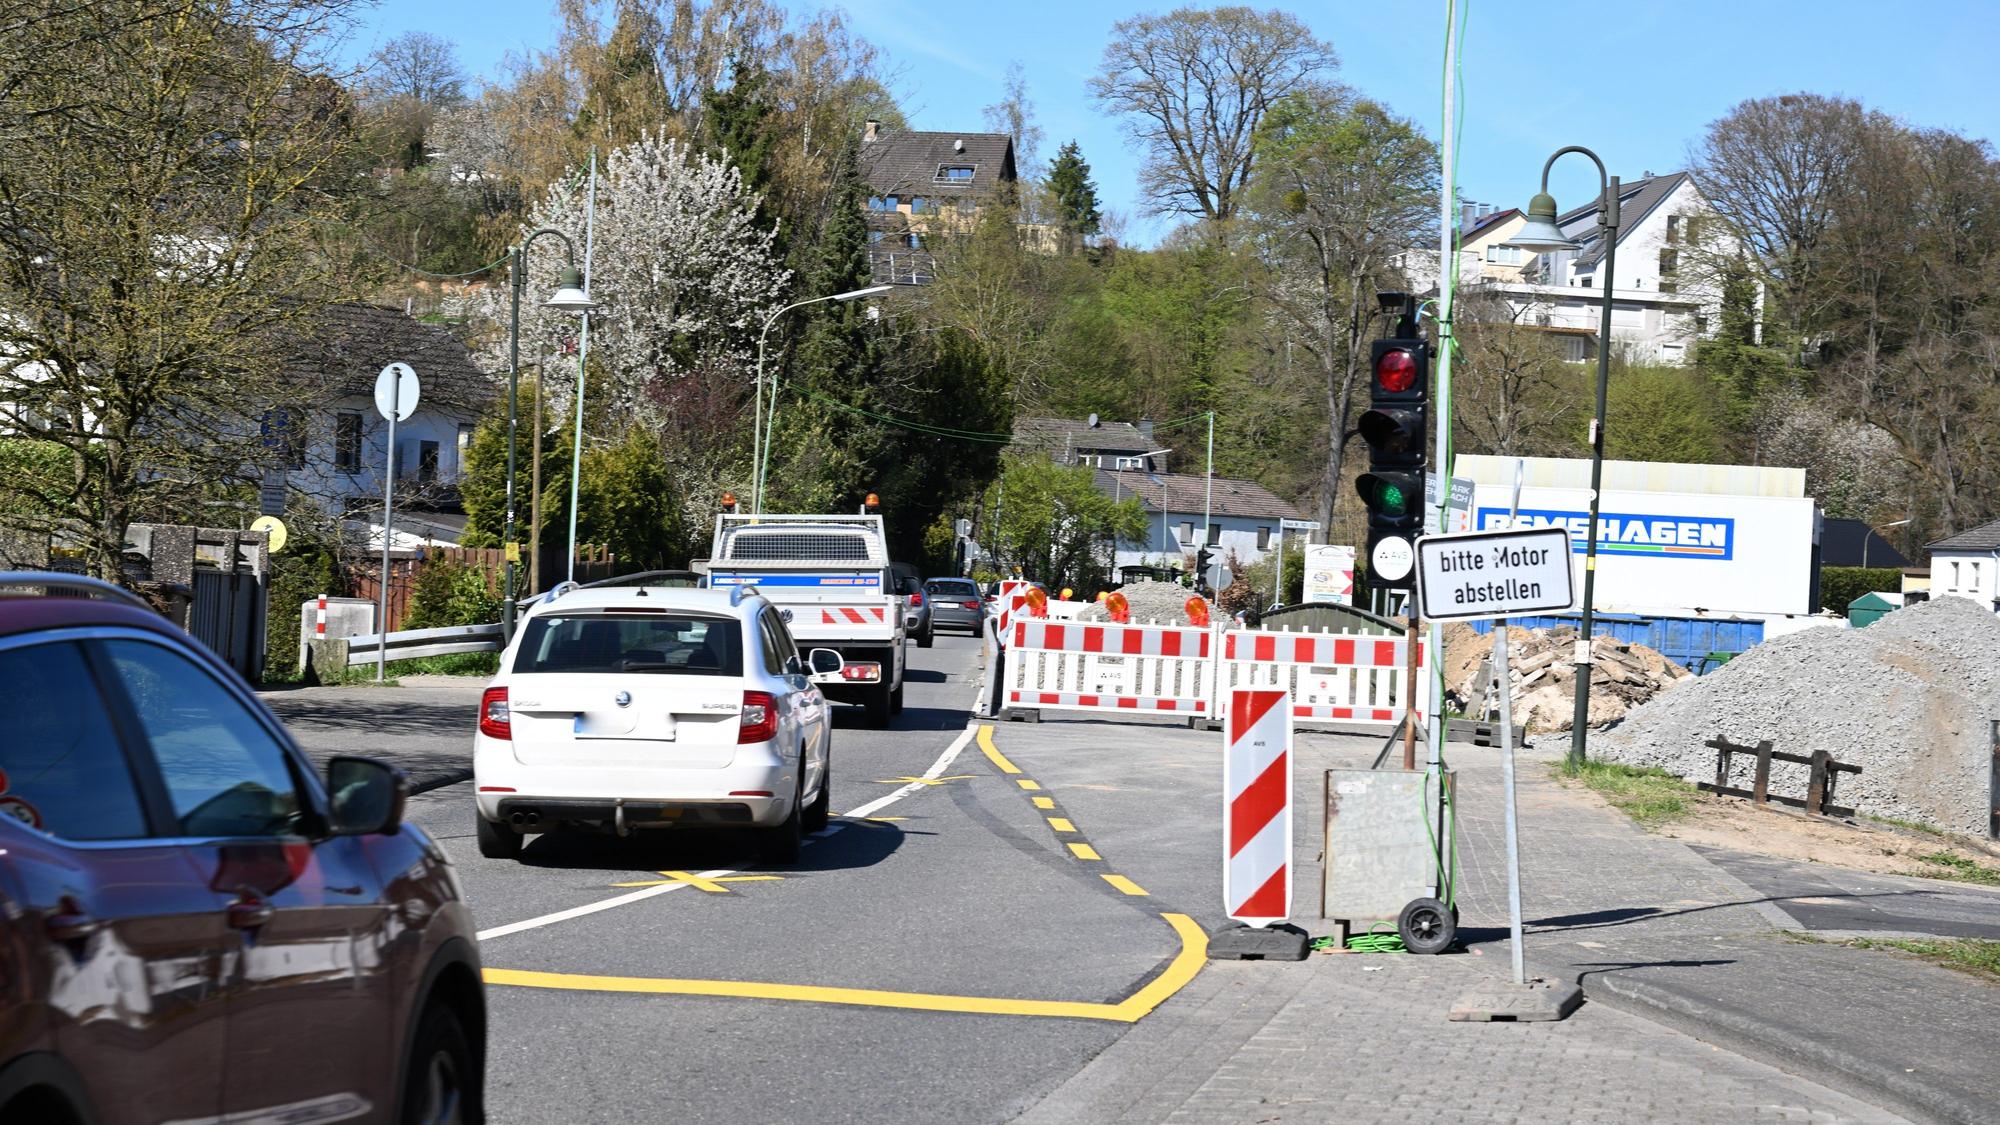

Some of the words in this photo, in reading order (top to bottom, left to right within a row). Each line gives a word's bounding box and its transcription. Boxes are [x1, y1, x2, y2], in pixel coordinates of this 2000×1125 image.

[1440, 550, 1484, 572] bitte
[1494, 546, 1549, 568] Motor
[1455, 578, 1541, 604] abstellen
